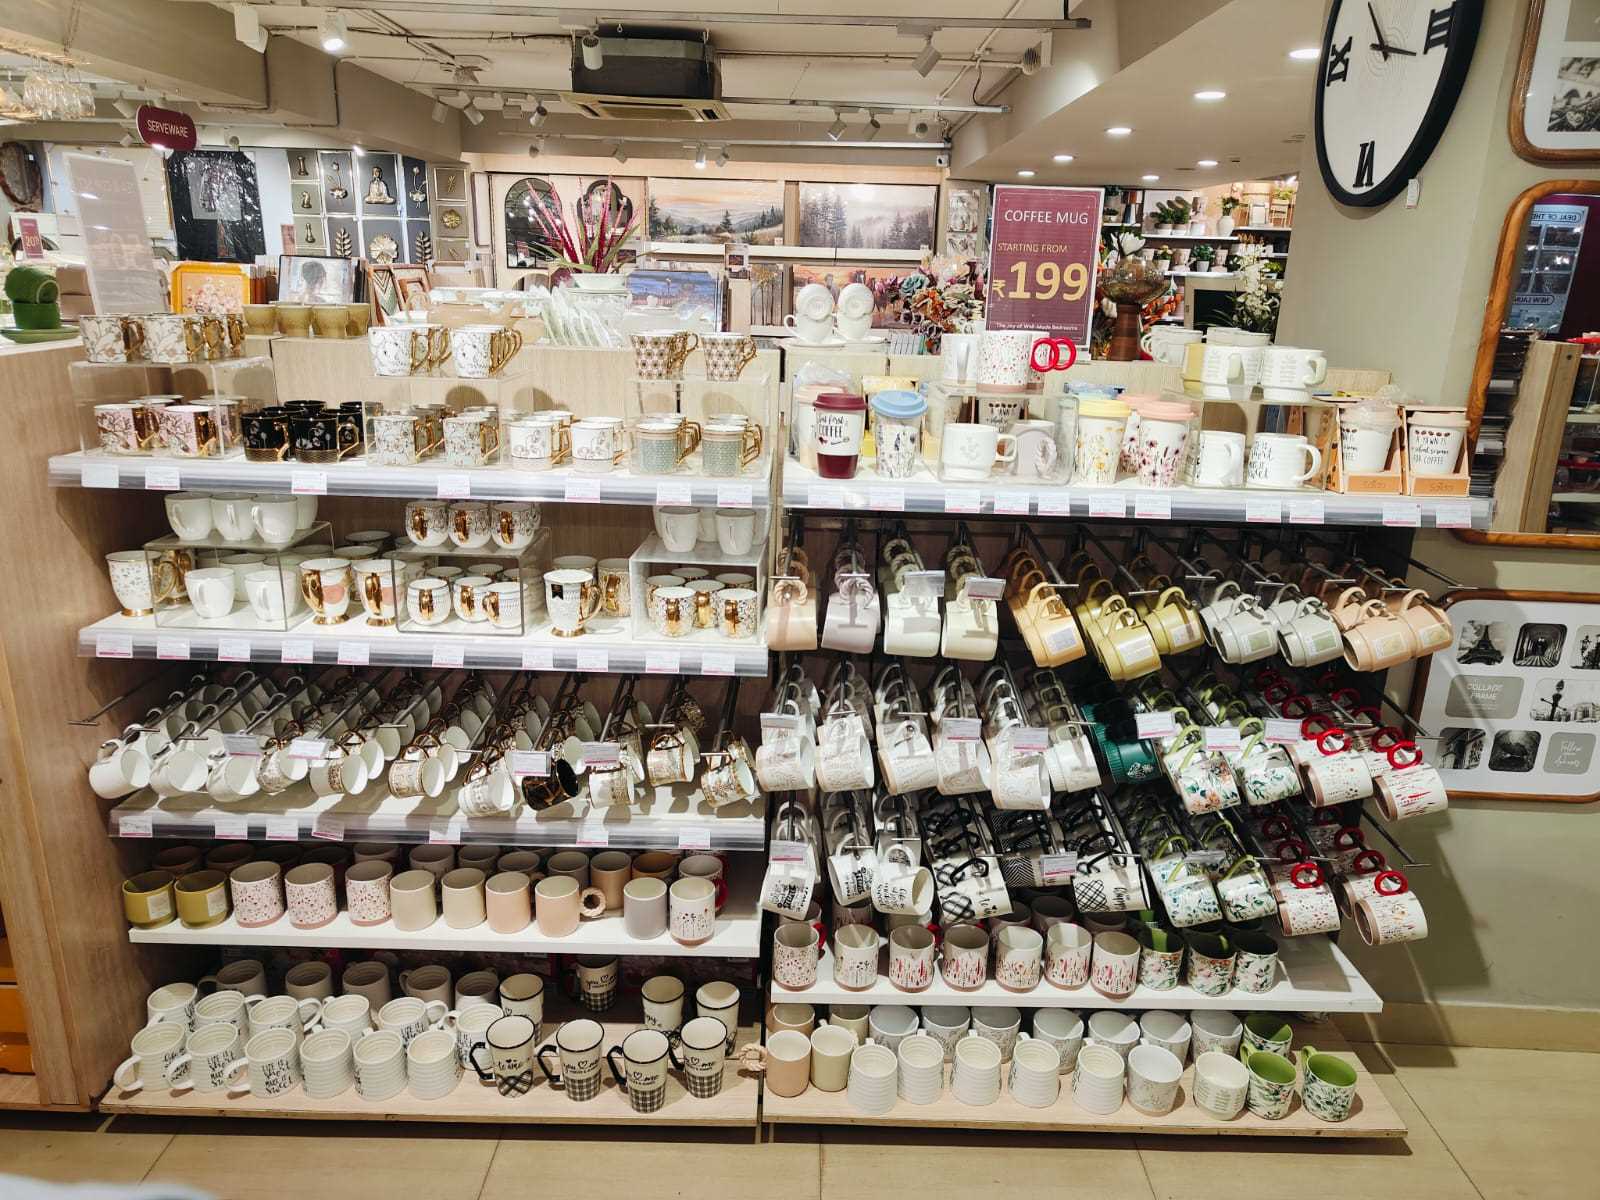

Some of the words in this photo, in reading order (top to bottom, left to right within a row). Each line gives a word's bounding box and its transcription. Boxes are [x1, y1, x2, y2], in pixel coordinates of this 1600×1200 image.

[146, 120, 190, 138] SERVEWARE
[1004, 209, 1052, 224] COFFEE
[1056, 212, 1089, 225] MUG
[997, 242, 1039, 253] STARTING
[1041, 243, 1068, 254] FROM
